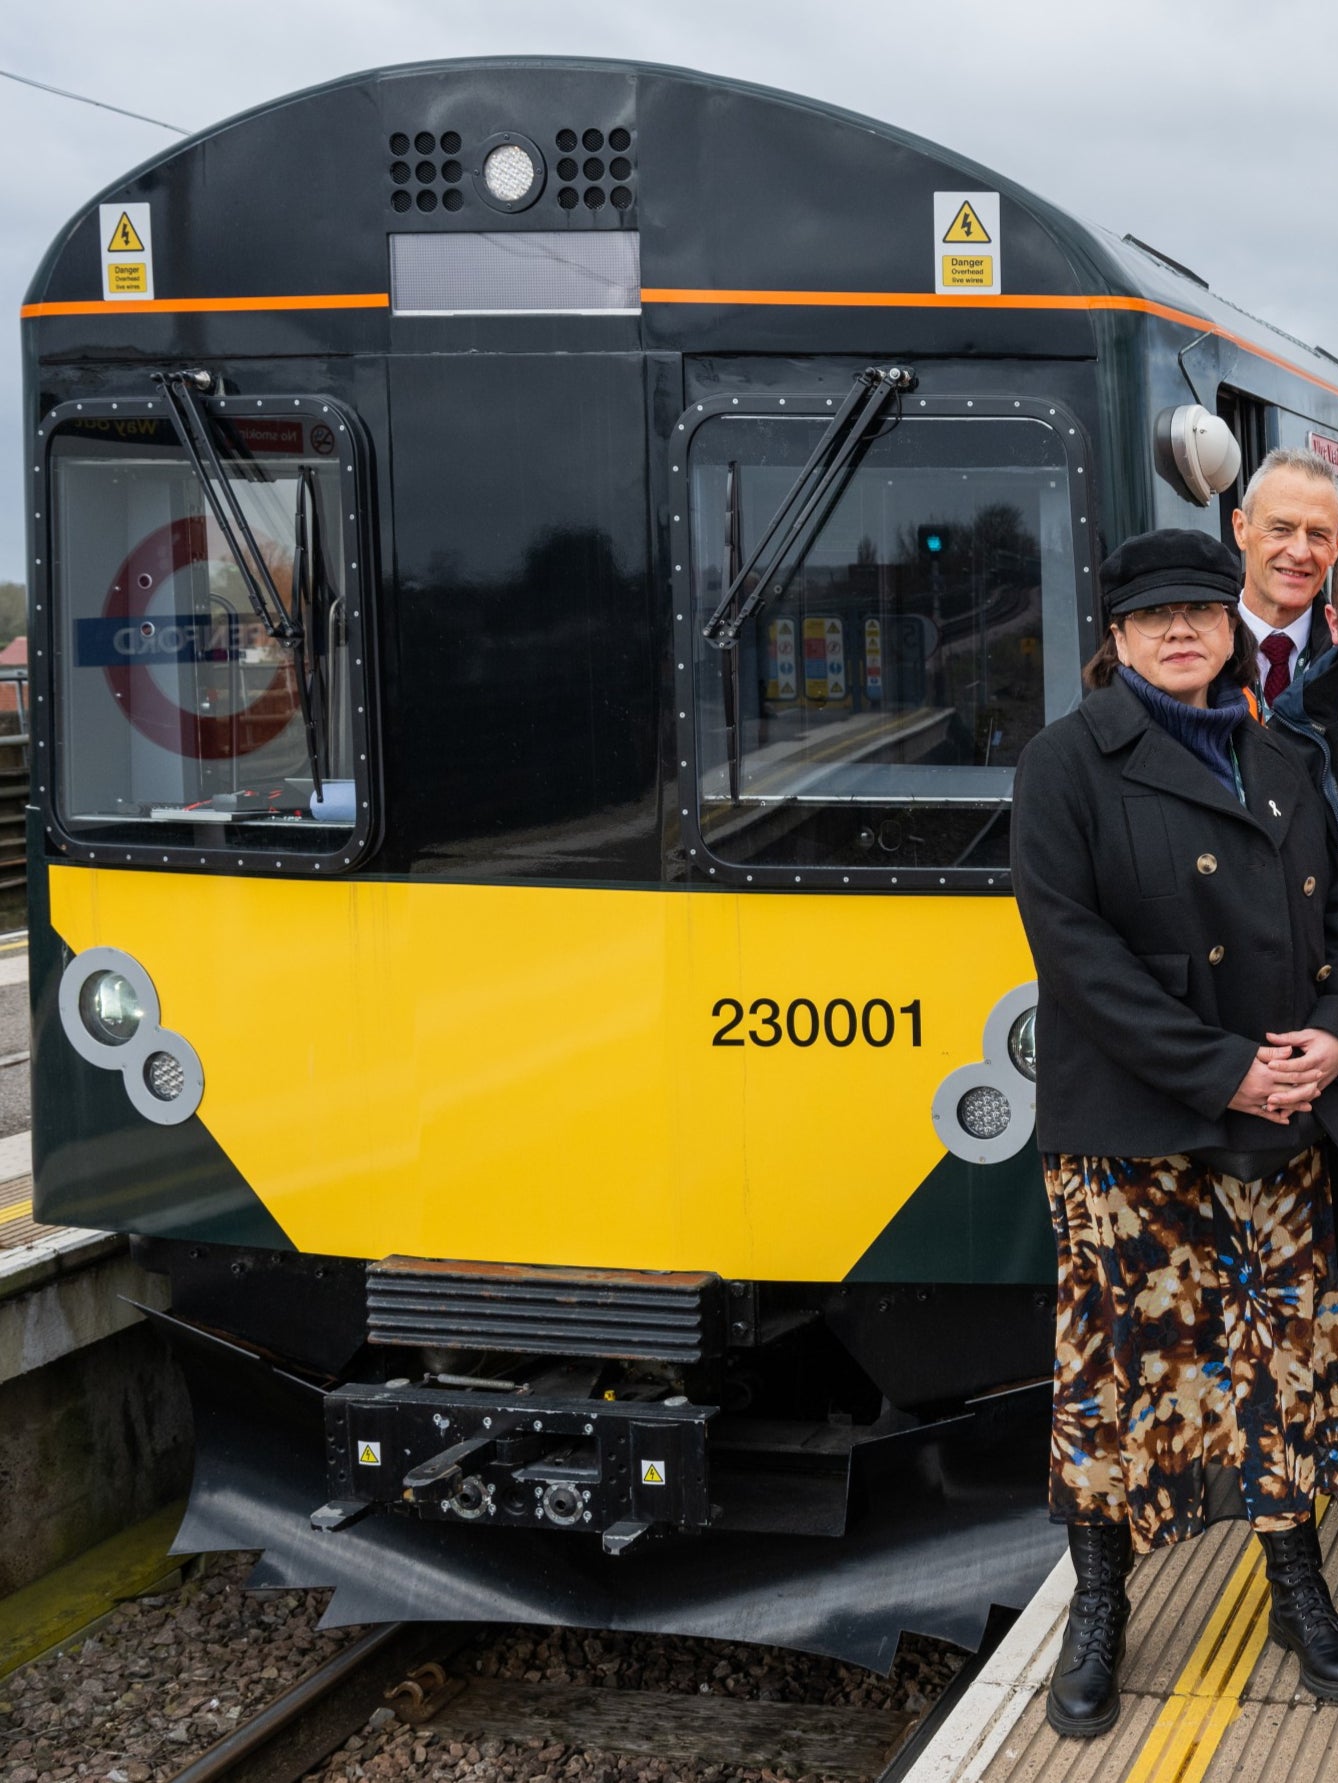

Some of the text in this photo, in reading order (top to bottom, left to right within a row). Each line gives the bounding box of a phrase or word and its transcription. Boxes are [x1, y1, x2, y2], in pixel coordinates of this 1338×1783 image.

[951, 257, 984, 268] Danger
[114, 265, 140, 275] Danger
[951, 268, 984, 276] Overhead
[711, 997, 922, 1048] 230001
